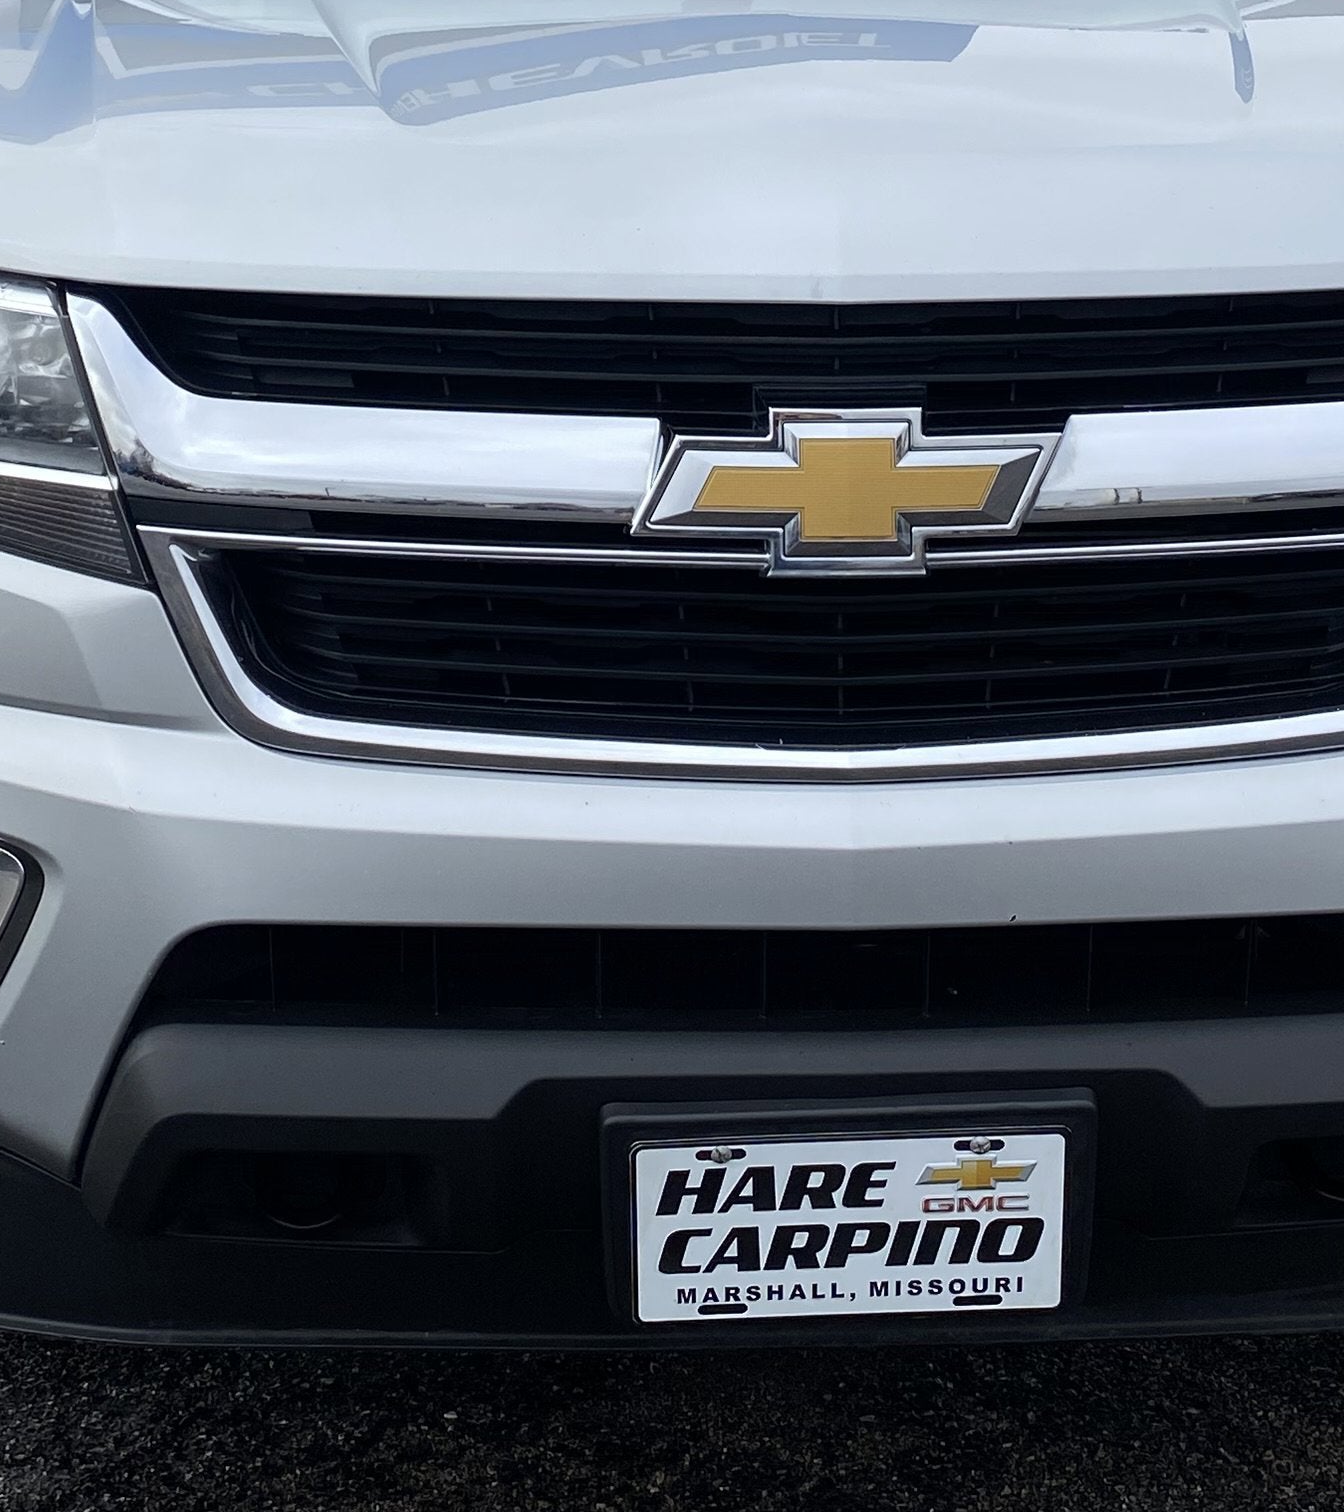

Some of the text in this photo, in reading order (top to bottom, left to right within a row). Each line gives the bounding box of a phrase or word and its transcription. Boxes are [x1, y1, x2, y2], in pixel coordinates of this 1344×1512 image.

[655, 1161, 897, 1216] HARE
[921, 1194, 1031, 1213] GMC
[657, 1217, 1046, 1275] CARPINO
[676, 1276, 1024, 1306] MARSHALL, MISSOURI
